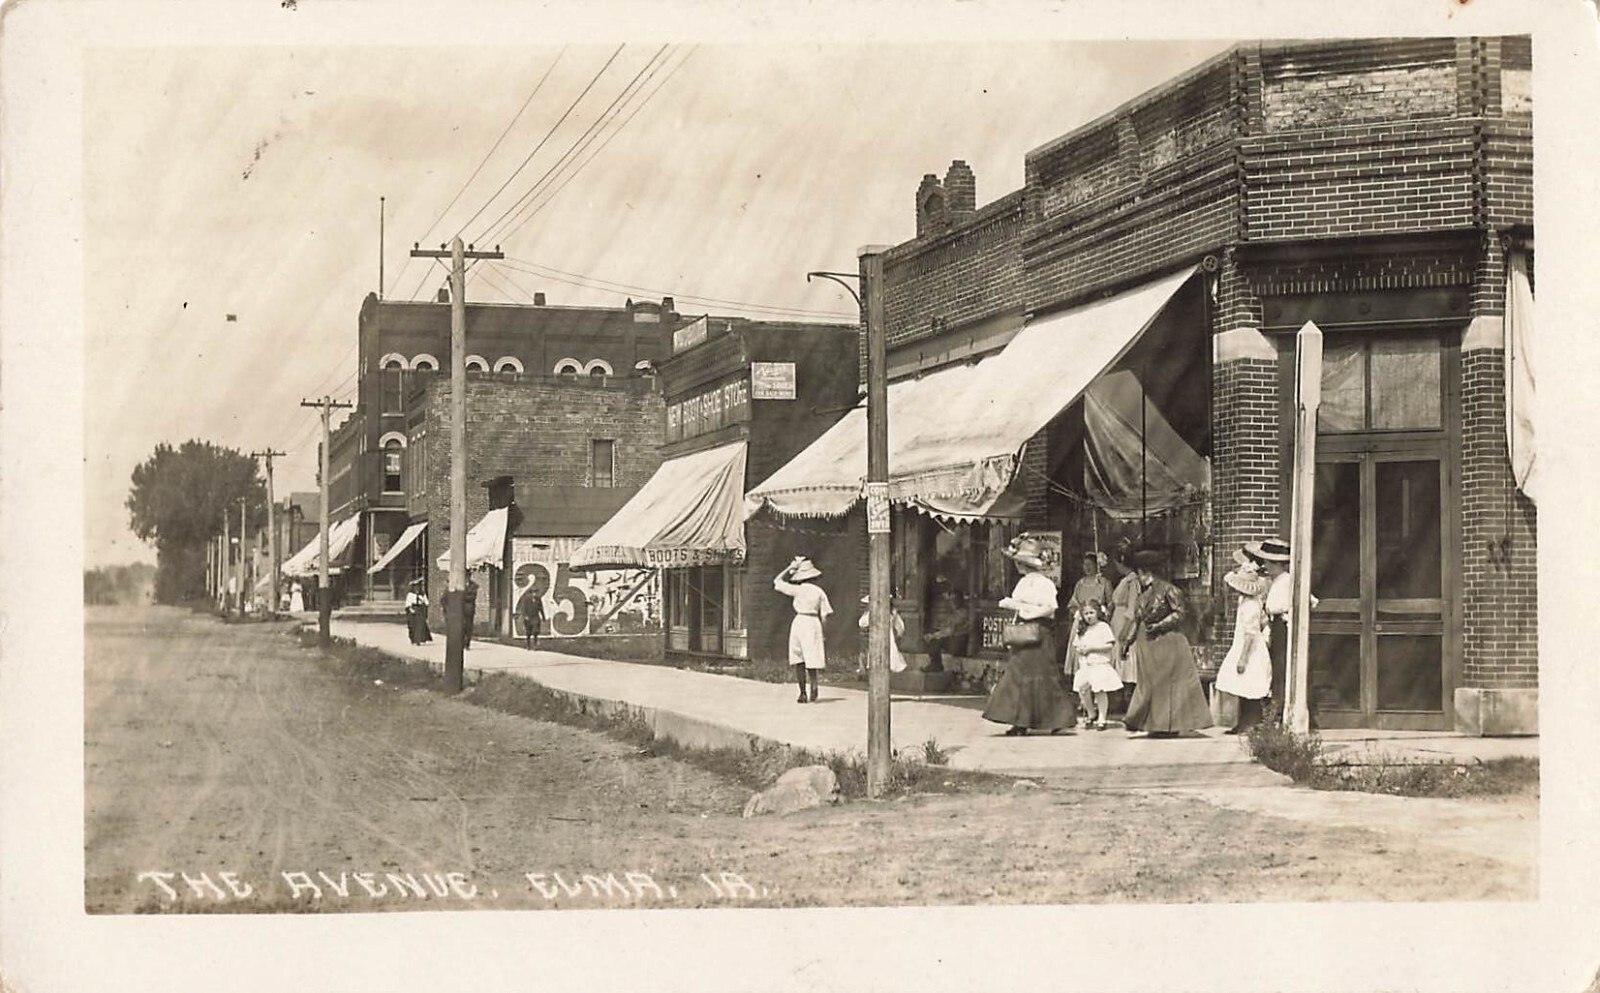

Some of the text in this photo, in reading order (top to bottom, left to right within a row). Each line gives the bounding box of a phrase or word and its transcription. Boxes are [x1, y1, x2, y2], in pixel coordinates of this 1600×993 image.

[683, 396, 700, 424] BOOT
[703, 389, 722, 418] SHOE
[724, 379, 748, 410] STORE
[648, 548, 688, 562] BOOTS
[693, 549, 700, 560] &
[515, 563, 588, 636] 25
[982, 617, 1003, 632] POST
